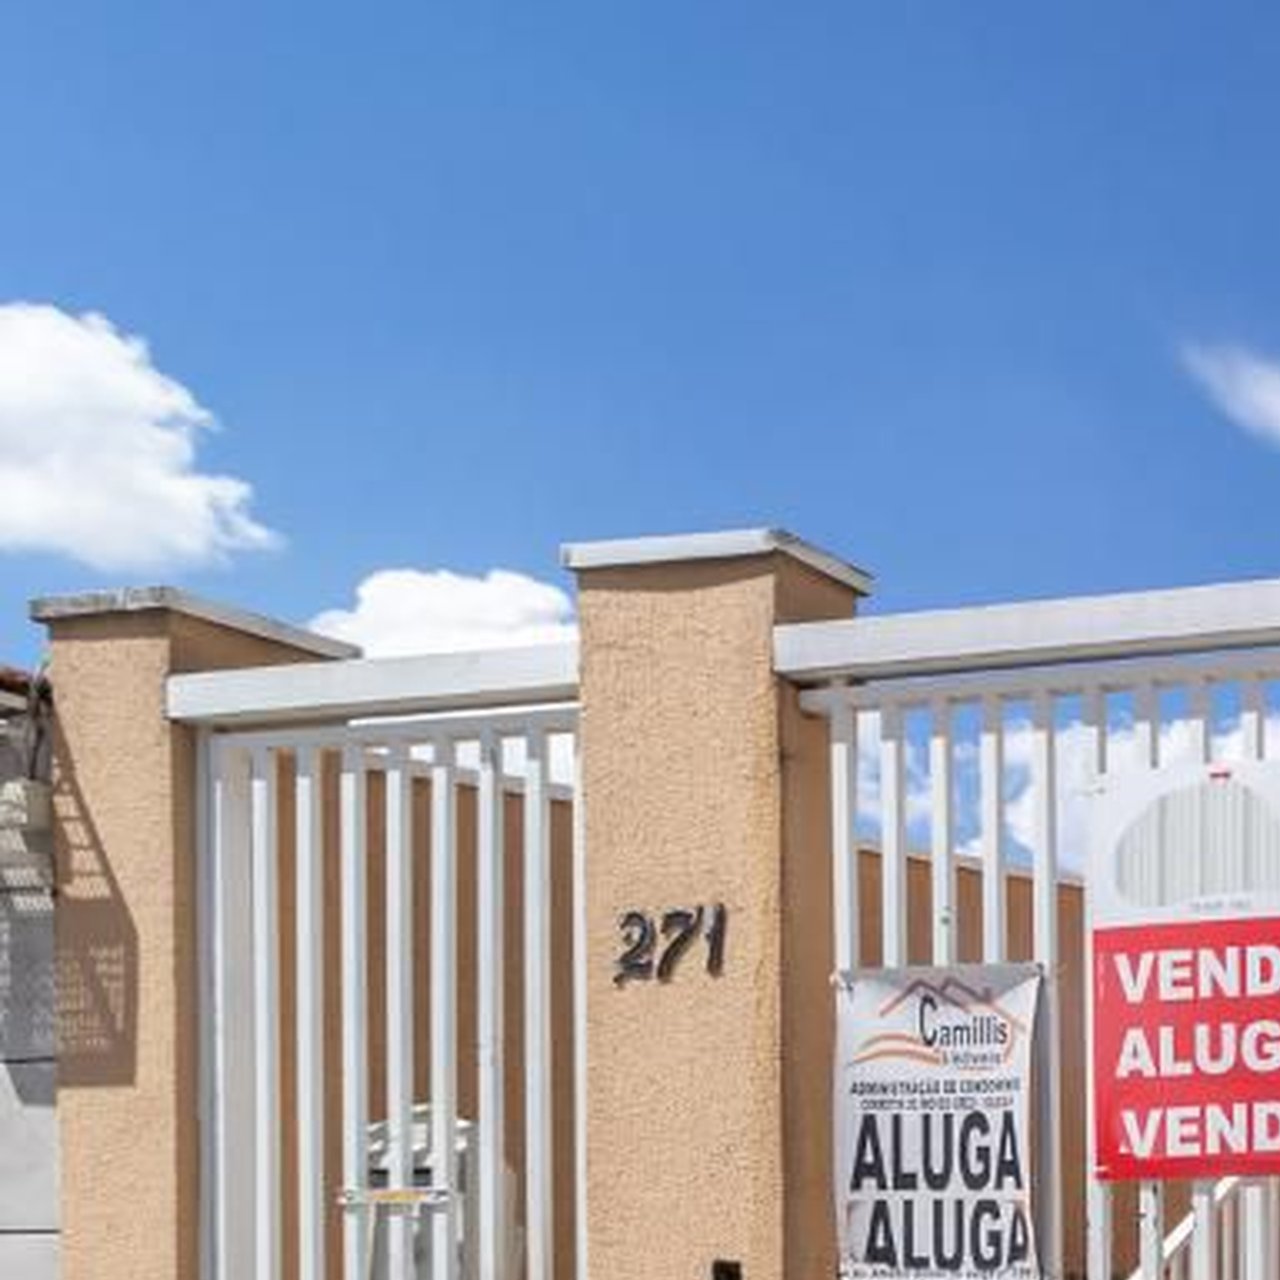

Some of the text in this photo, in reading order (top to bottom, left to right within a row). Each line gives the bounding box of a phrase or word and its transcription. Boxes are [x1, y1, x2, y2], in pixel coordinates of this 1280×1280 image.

[612, 902, 728, 989] 271
[918, 995, 1008, 1047] Camillis
[850, 1110, 1023, 1191] ALUGA
[863, 1199, 1030, 1271] ALUGA
